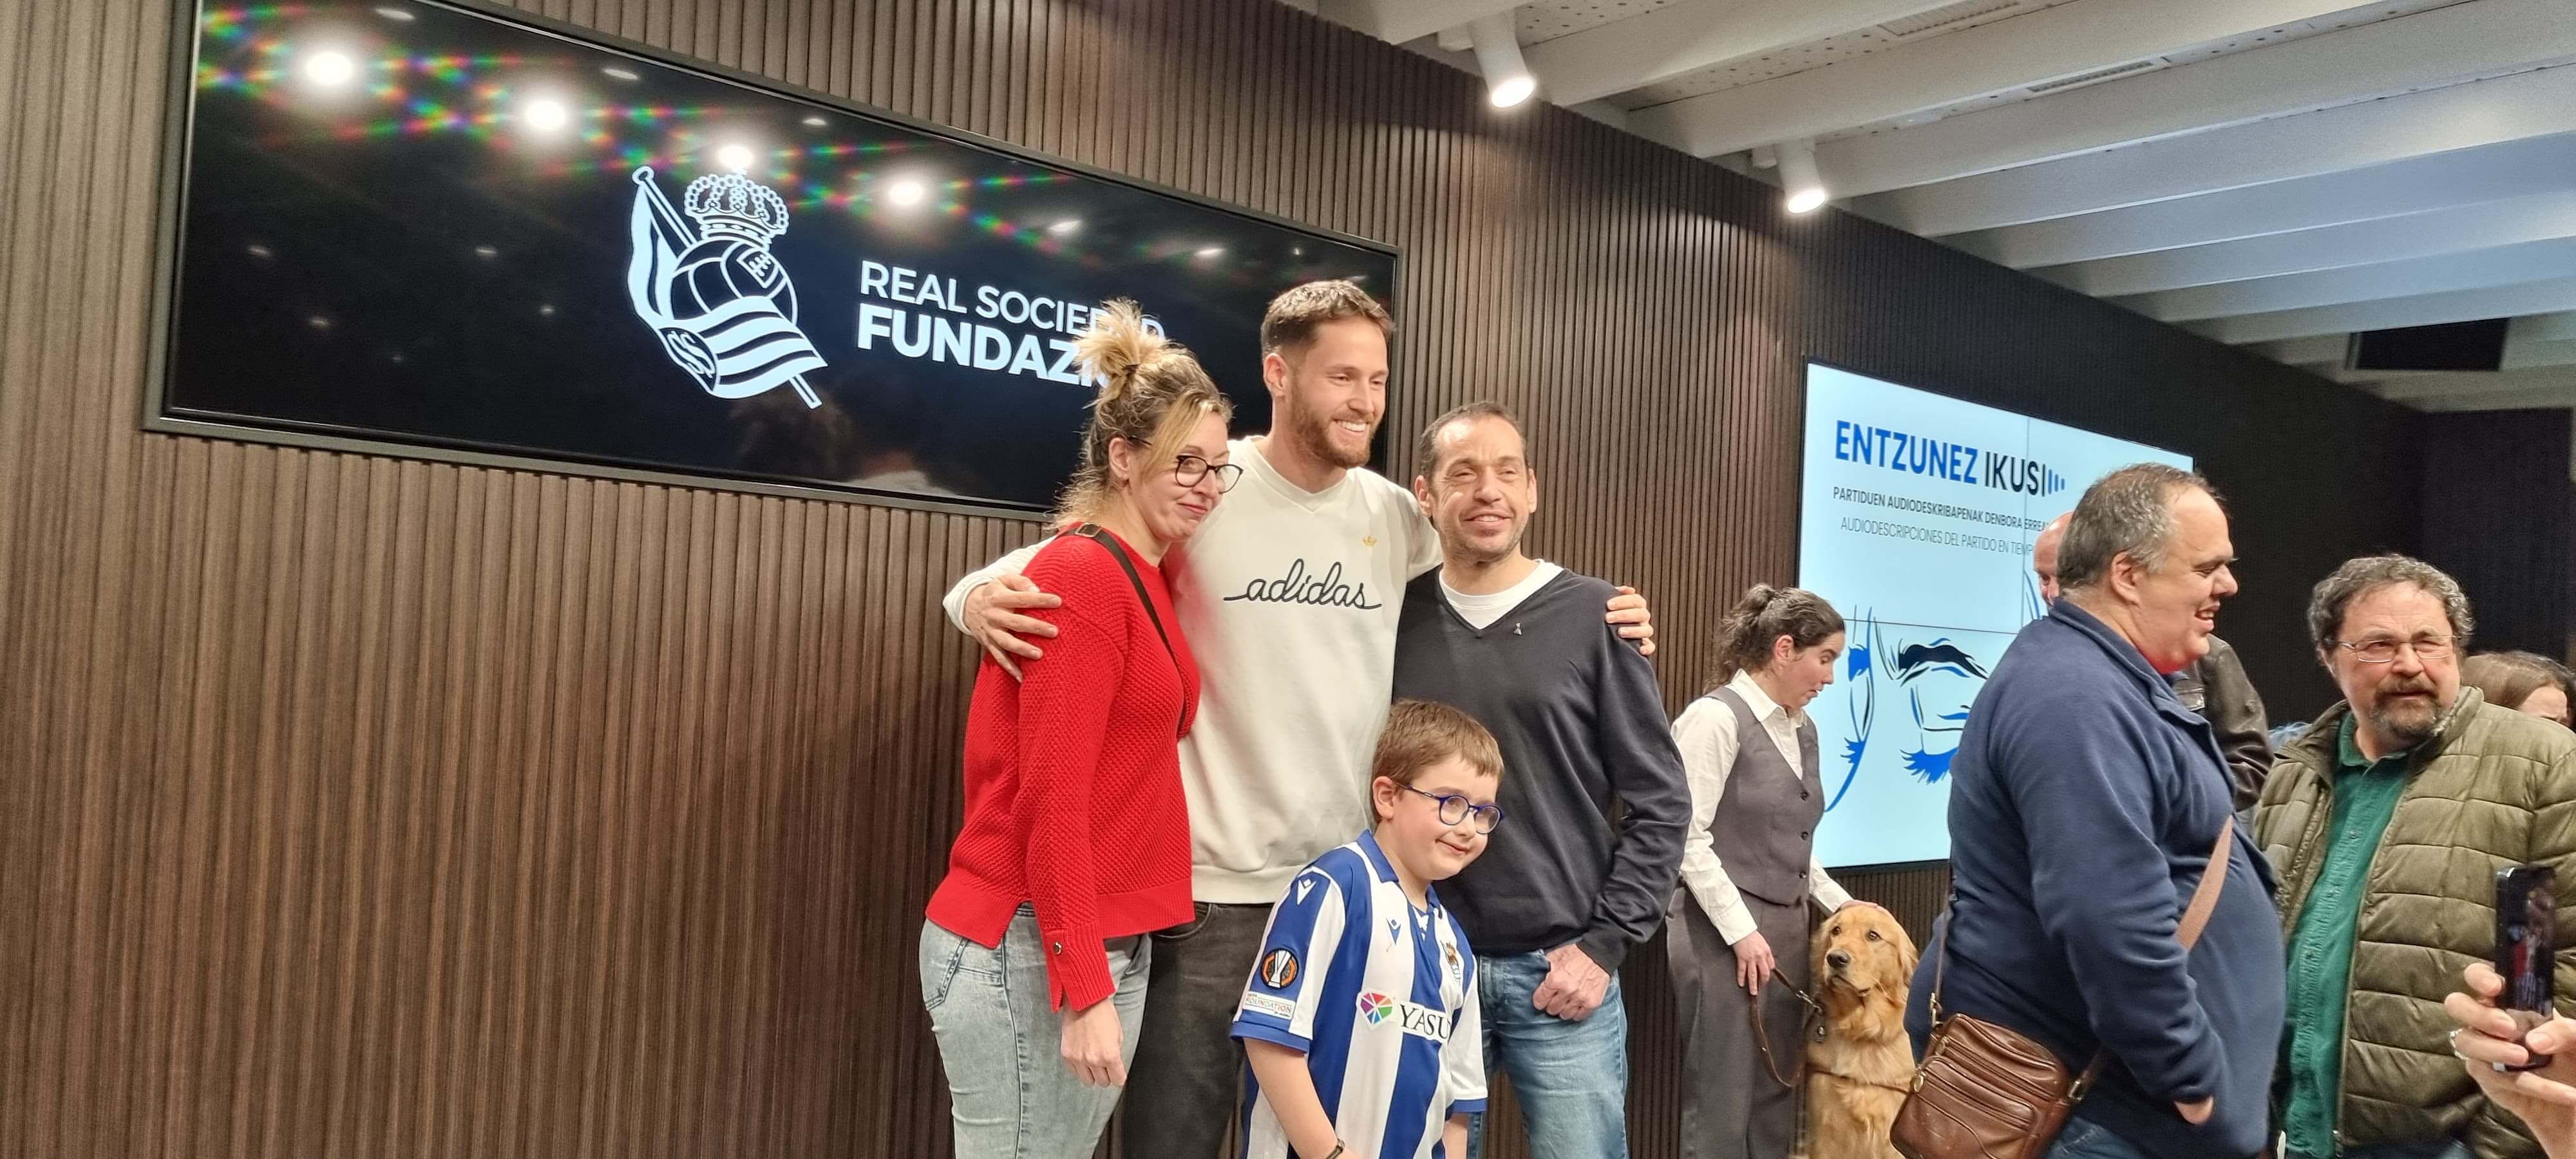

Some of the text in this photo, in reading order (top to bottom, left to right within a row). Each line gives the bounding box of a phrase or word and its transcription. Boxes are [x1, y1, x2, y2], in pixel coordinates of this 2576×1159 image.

[860, 260, 1164, 343] REAL SOCIED
[857, 303, 1108, 388] FUNDAZI
[1835, 420, 1978, 484] ENTZUNEZ
[1833, 486, 1886, 507] PARTIDUEN
[1887, 495, 1984, 523] AUDIODESKRIBAPENAK
[1985, 512, 2023, 528] DENBORA
[1841, 516, 1942, 543] AUDIODESCRIPCIONES
[1944, 531, 1959, 547] DEL
[1962, 534, 1996, 551] PARTIDO
[1998, 540, 2009, 552] EN
[1224, 558, 1382, 609] adidas
